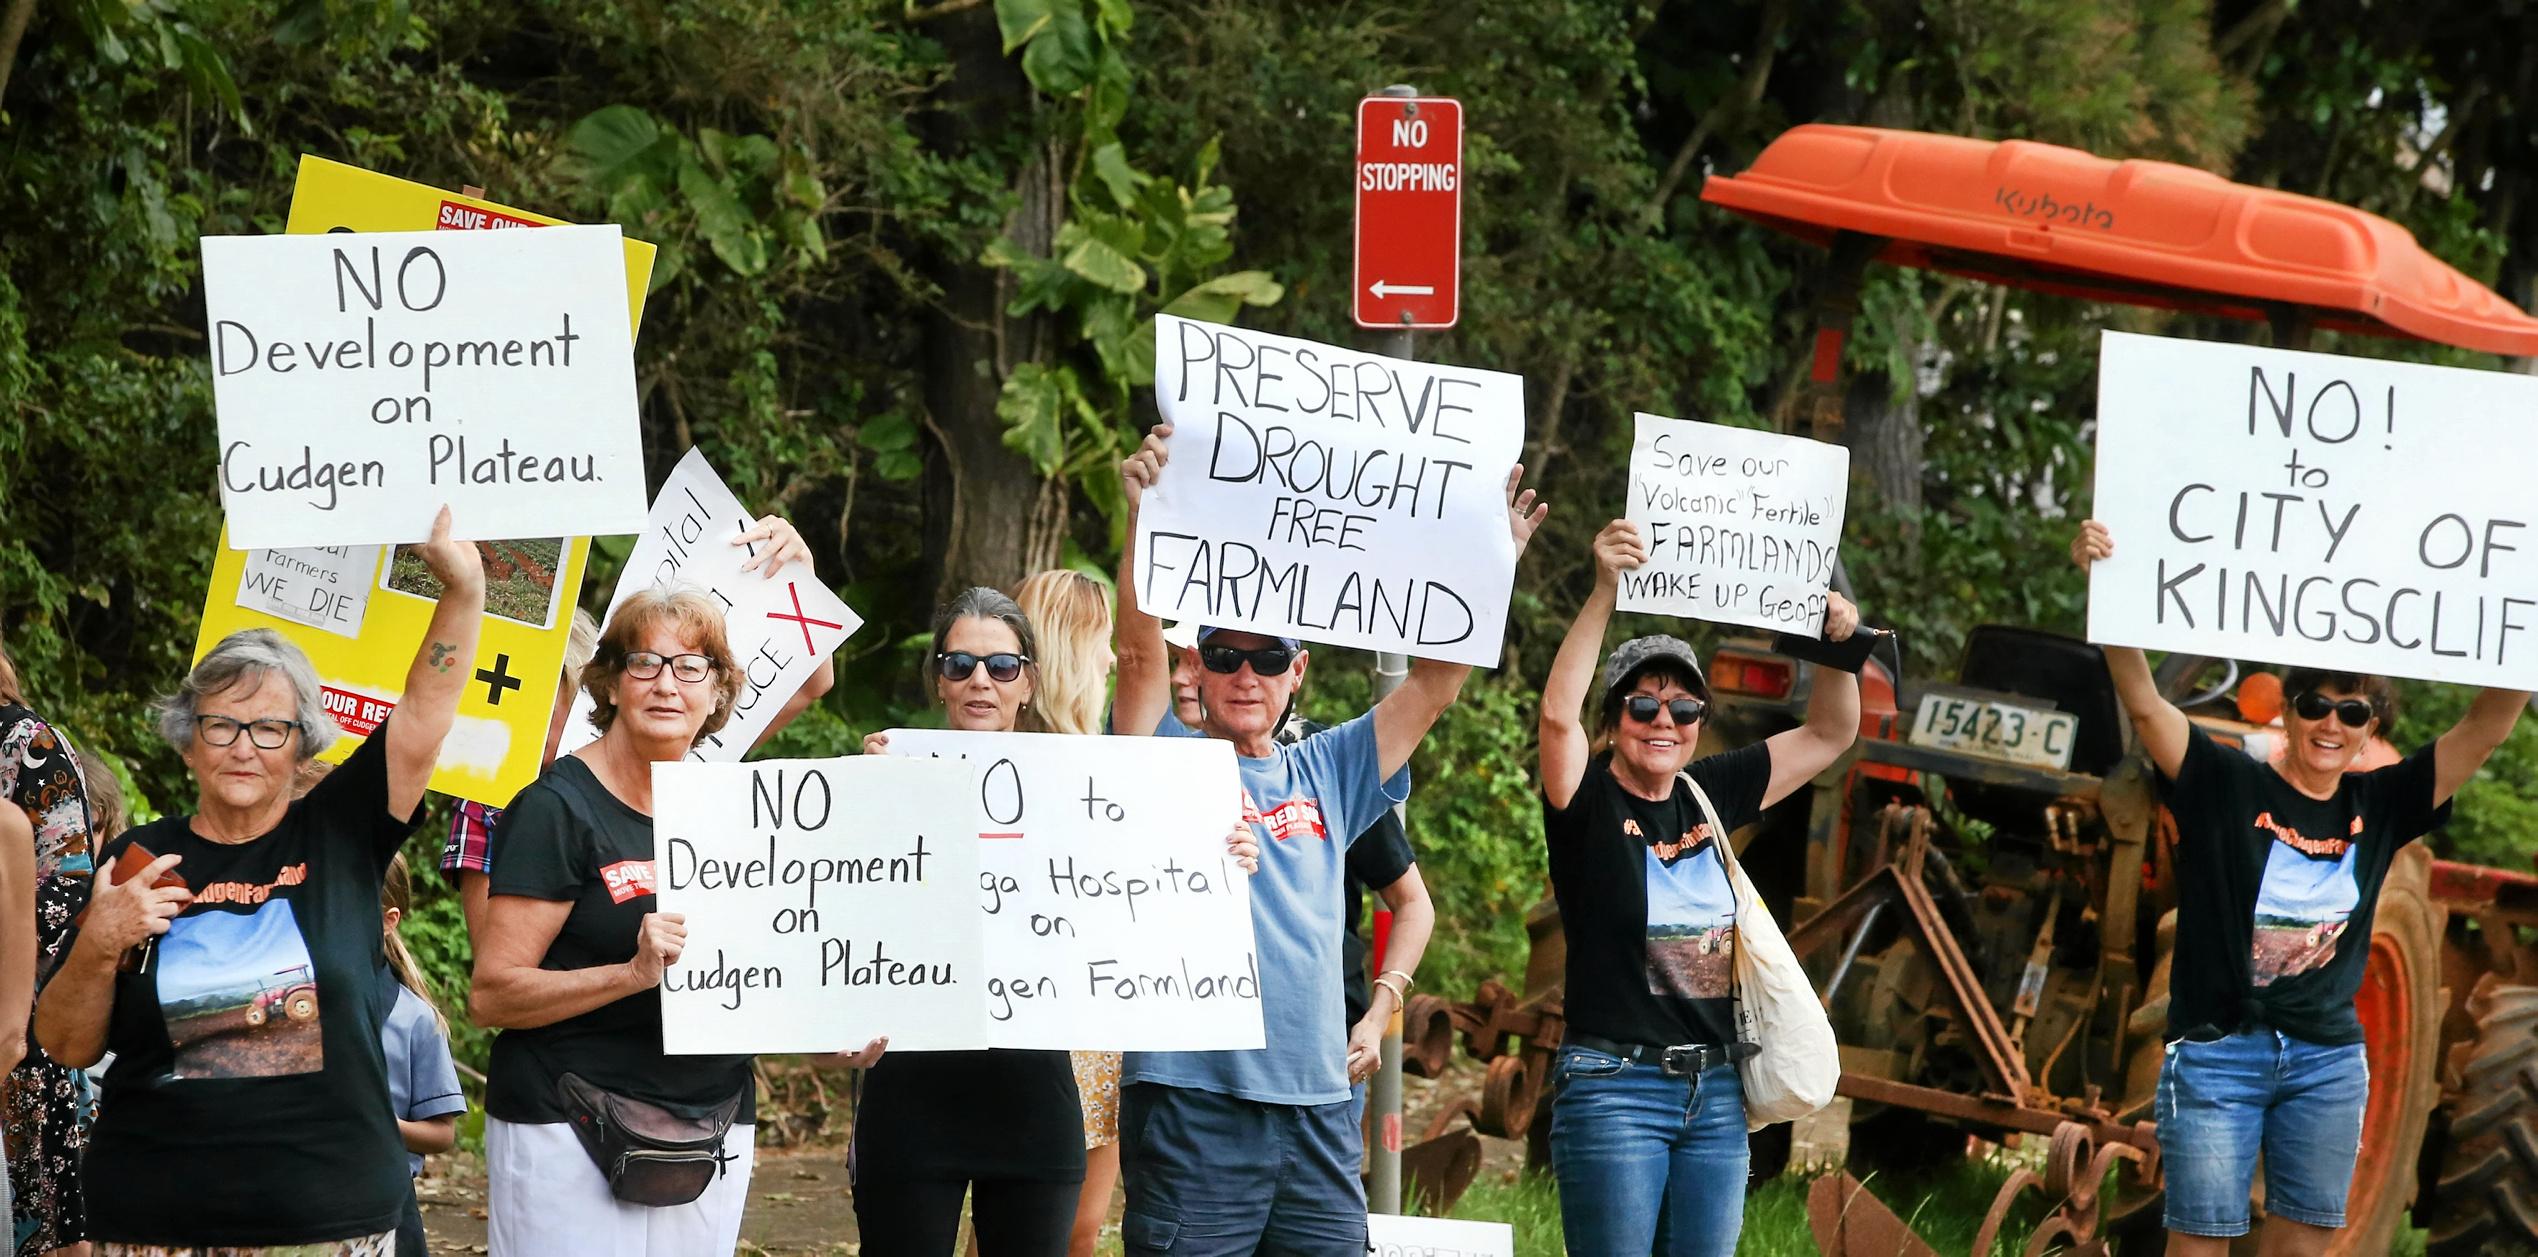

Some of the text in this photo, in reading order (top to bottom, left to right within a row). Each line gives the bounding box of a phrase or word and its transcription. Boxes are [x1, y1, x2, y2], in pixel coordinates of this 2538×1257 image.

[1392, 119, 1428, 148] NO
[1361, 162, 1456, 192] STOPPING
[440, 205, 487, 231] SAVE
[1996, 186, 2113, 230] Kubota
[333, 245, 446, 312] NO
[216, 313, 580, 391] Development
[371, 394, 431, 424] on
[1178, 321, 1481, 443] PRESERVE
[2248, 366, 2394, 450] NO!
[223, 434, 604, 511] Cudgen Plateau.
[1209, 411, 1473, 519] DROUGHT
[1652, 434, 1789, 478] Save our
[2284, 448, 2329, 488] to
[655, 486, 713, 592] pital
[1268, 497, 1377, 551] FREE
[2169, 483, 2526, 578] CITY OF
[1649, 522, 1836, 588] FARMLANDS
[245, 568, 353, 622] WE DIE
[1147, 531, 1474, 645] FARMLAND
[1623, 571, 1701, 600] WAKE
[1715, 583, 1748, 608] UP
[2156, 558, 2537, 666] KINGSCLIF
[321, 691, 393, 723] OUR RE
[752, 769, 831, 831] NO
[981, 757, 1125, 825] O to
[1263, 804, 1298, 830] RED
[605, 864, 653, 888] SAVE
[668, 835, 932, 908] Development
[980, 856, 1232, 923] ga Hospital
[772, 908, 819, 934] on
[1031, 913, 1076, 938] on
[822, 938, 957, 986] Plateau.
[987, 952, 1260, 1021] gen Farmland
